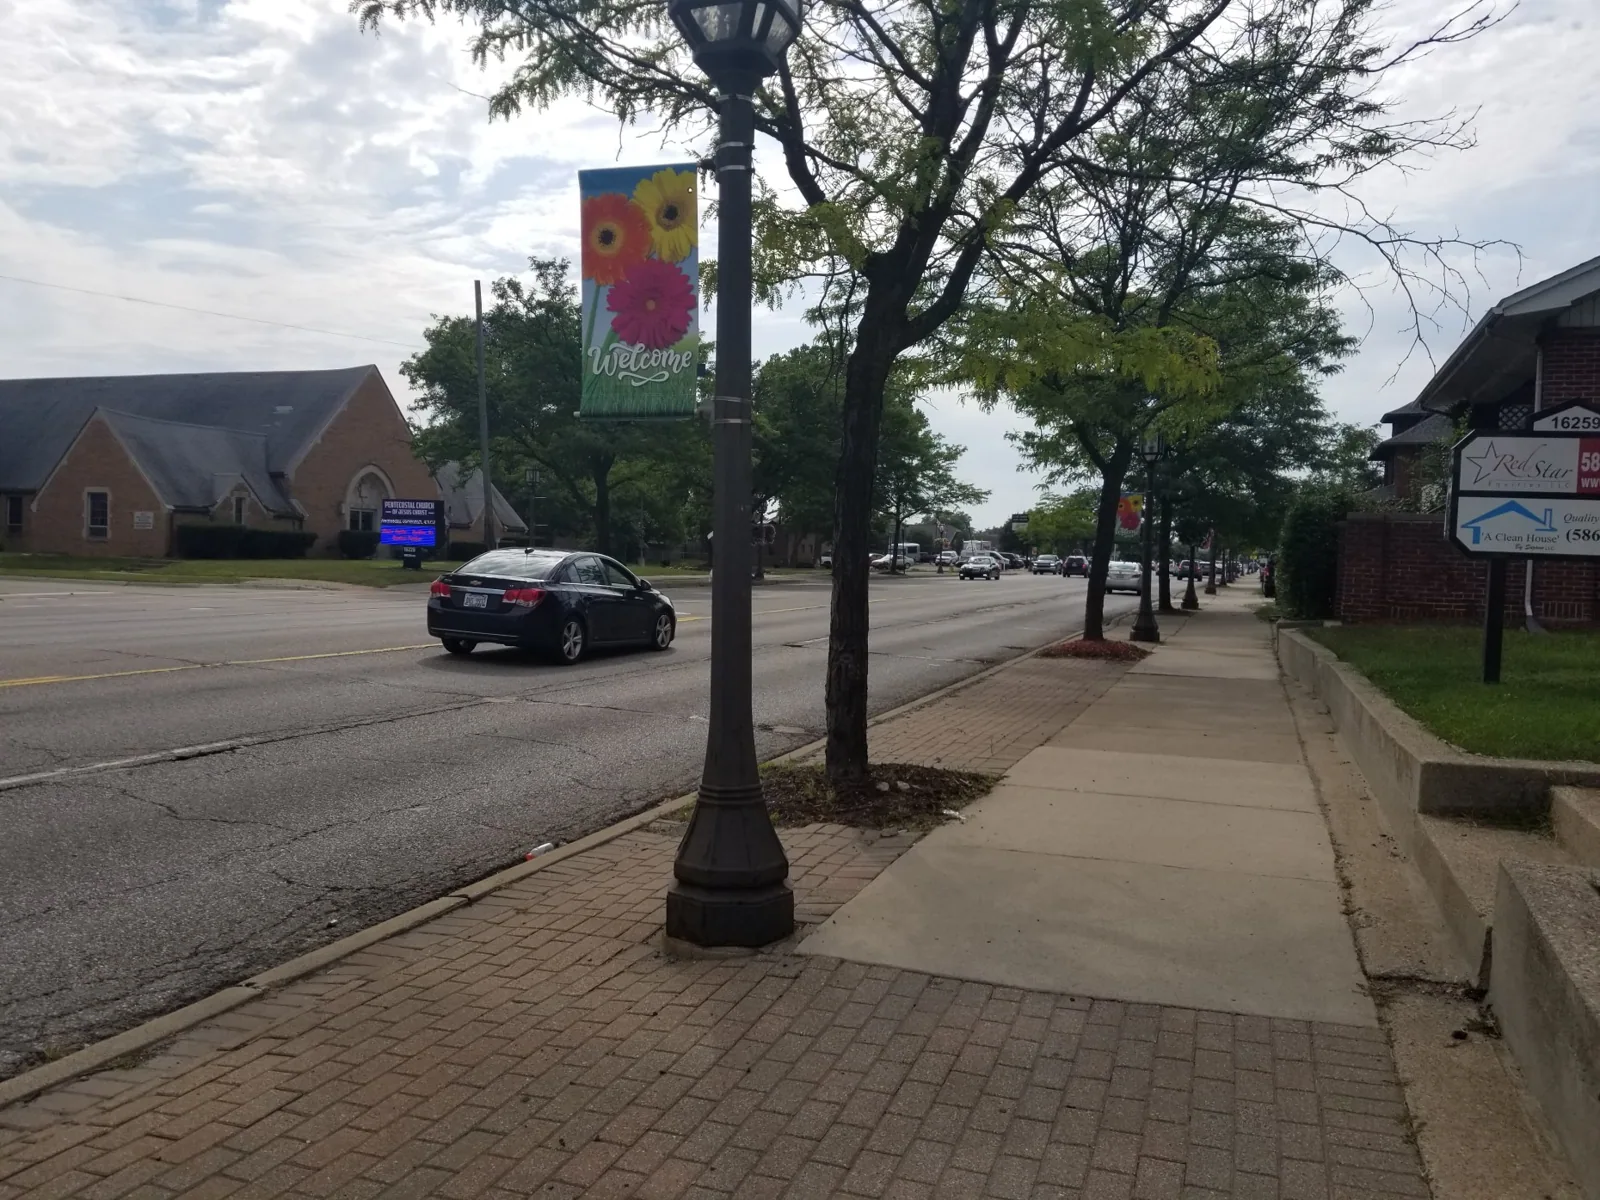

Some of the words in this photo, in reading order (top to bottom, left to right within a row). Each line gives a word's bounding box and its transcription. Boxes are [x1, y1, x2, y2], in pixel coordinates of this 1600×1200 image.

[588, 343, 692, 376] Welcome
[1551, 416, 1600, 430] 16259
[1493, 444, 1547, 478] Red
[1528, 460, 1573, 479] Star
[416, 501, 435, 509] CHURCH
[1563, 513, 1599, 525] Quality
[1495, 530, 1523, 543] Clean
